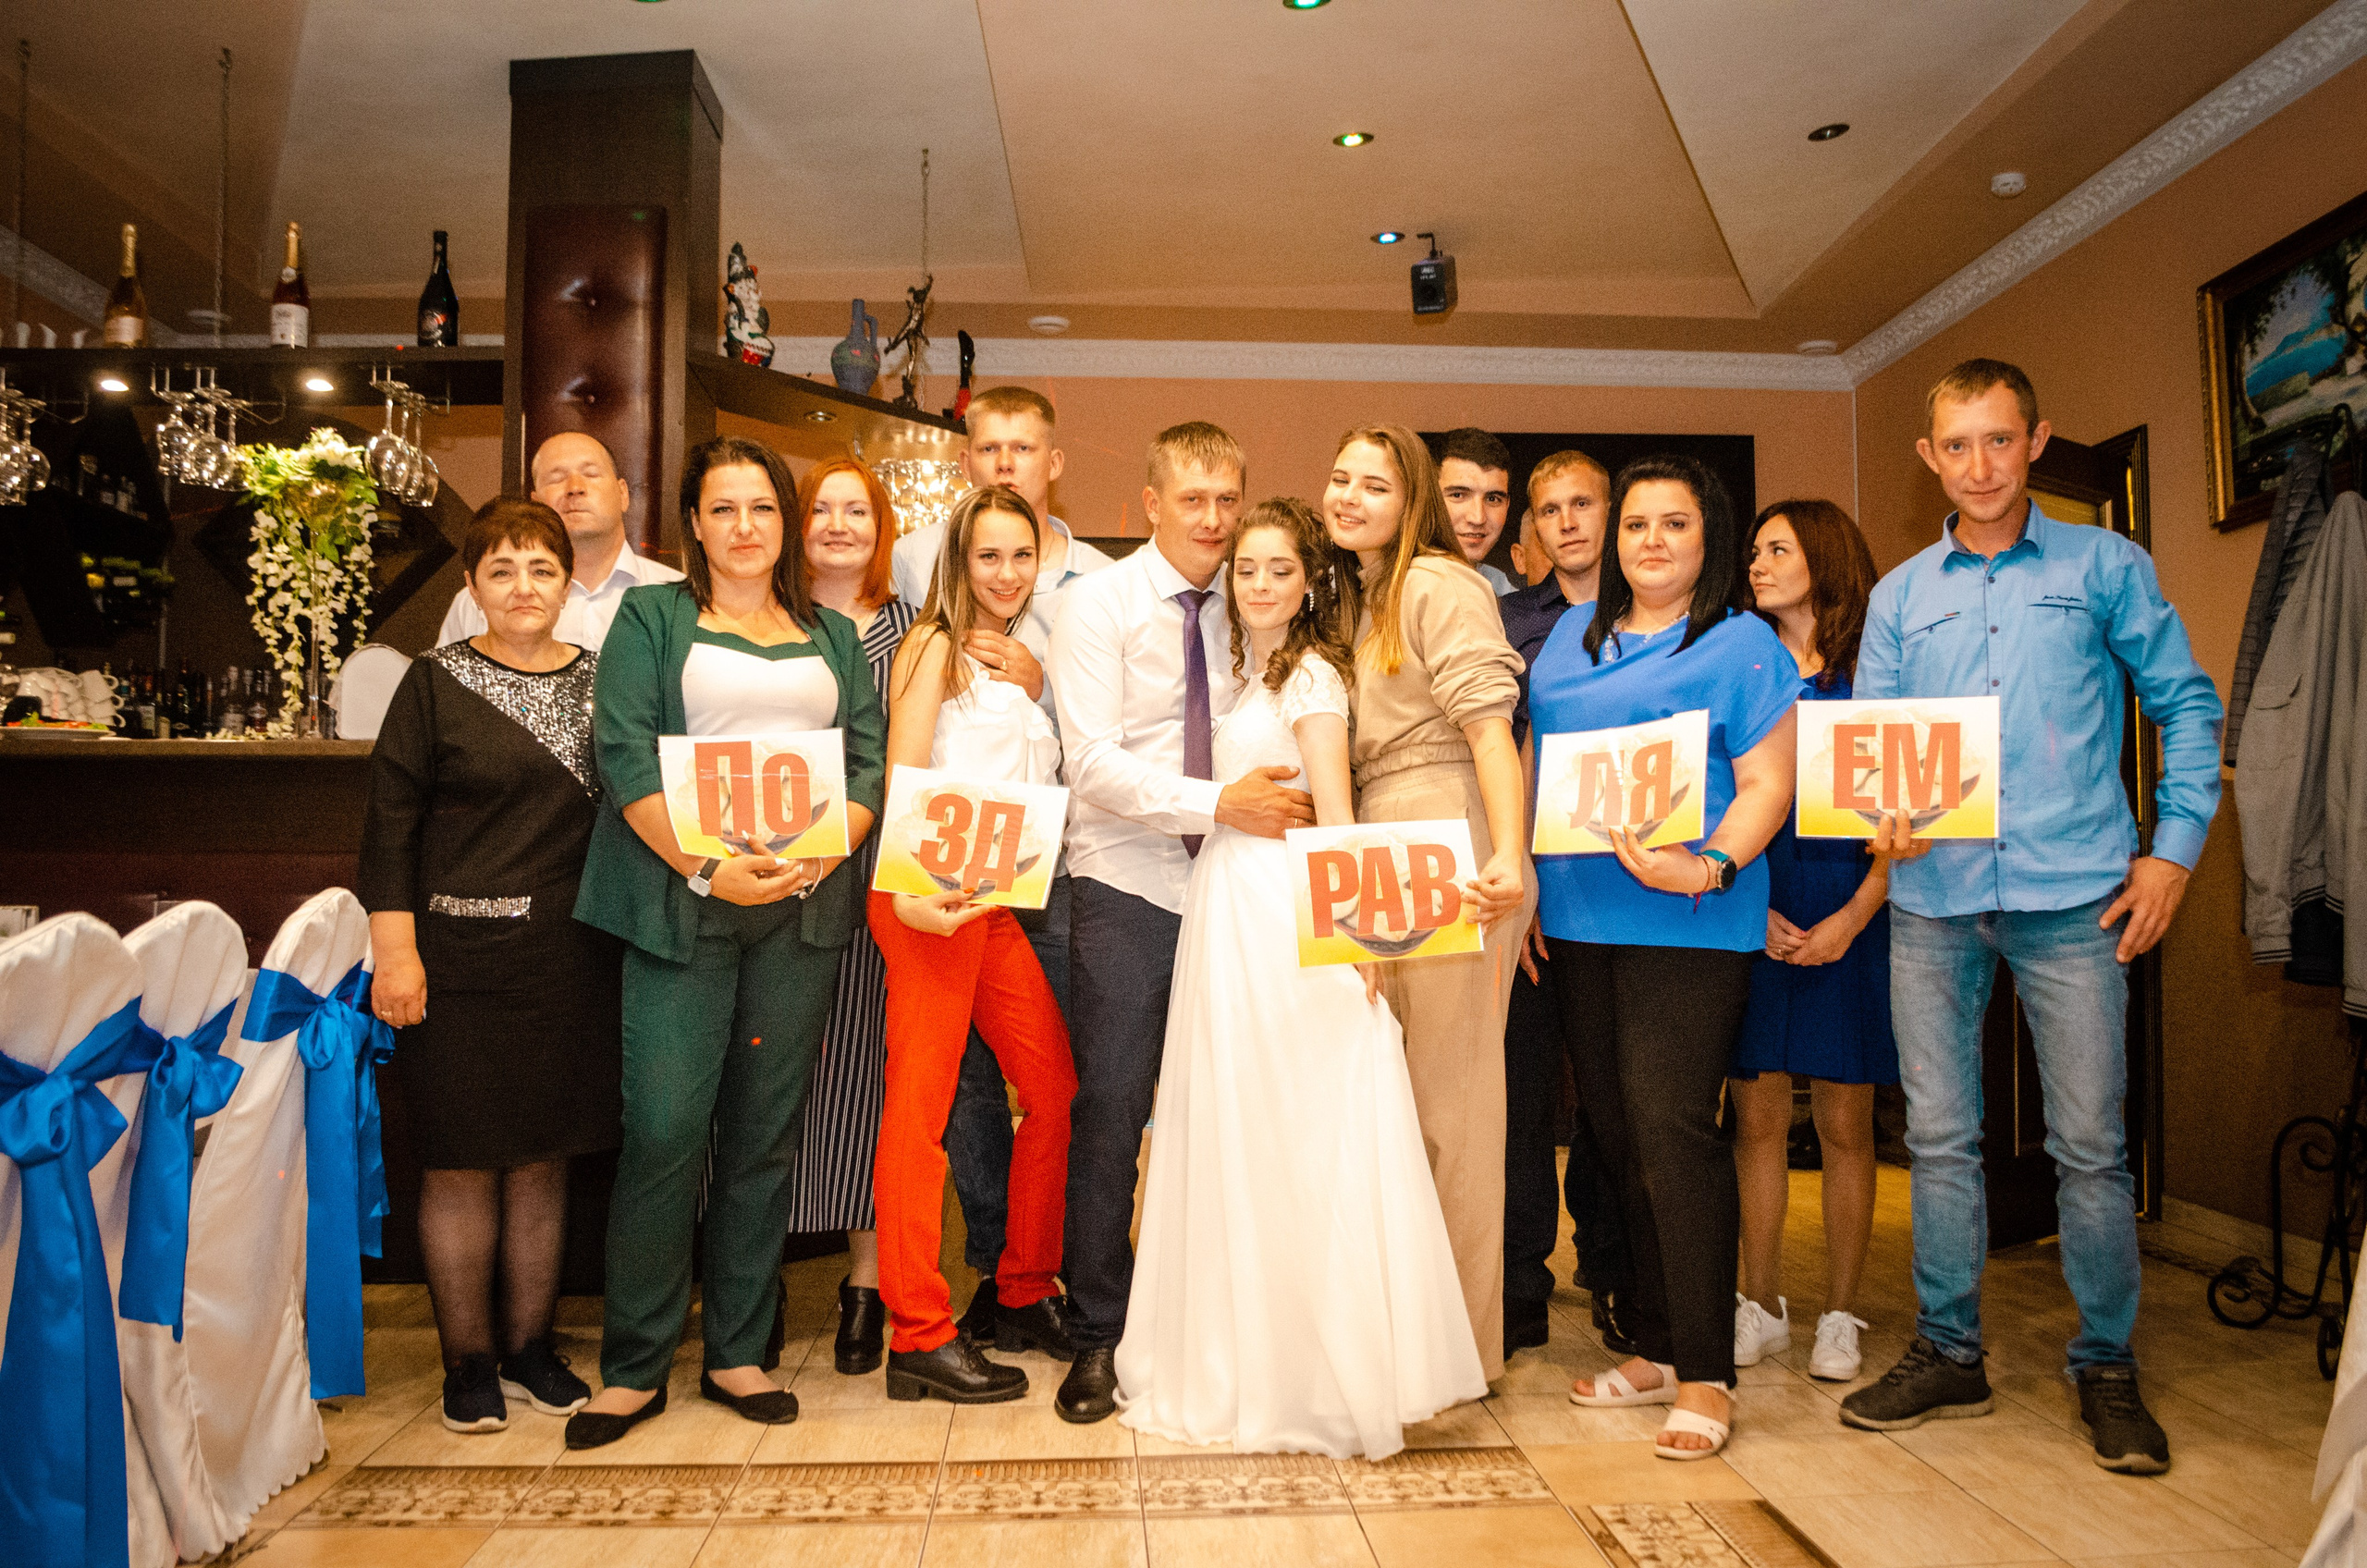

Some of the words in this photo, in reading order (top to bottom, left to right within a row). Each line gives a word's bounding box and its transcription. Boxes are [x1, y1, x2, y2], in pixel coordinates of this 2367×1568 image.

[694, 741, 813, 837] ПО
[1569, 741, 1673, 829] ЛЯ
[1834, 722, 1960, 809] ЕМ
[919, 793, 1026, 892] ЗД
[1306, 843, 1461, 938] РАВ
